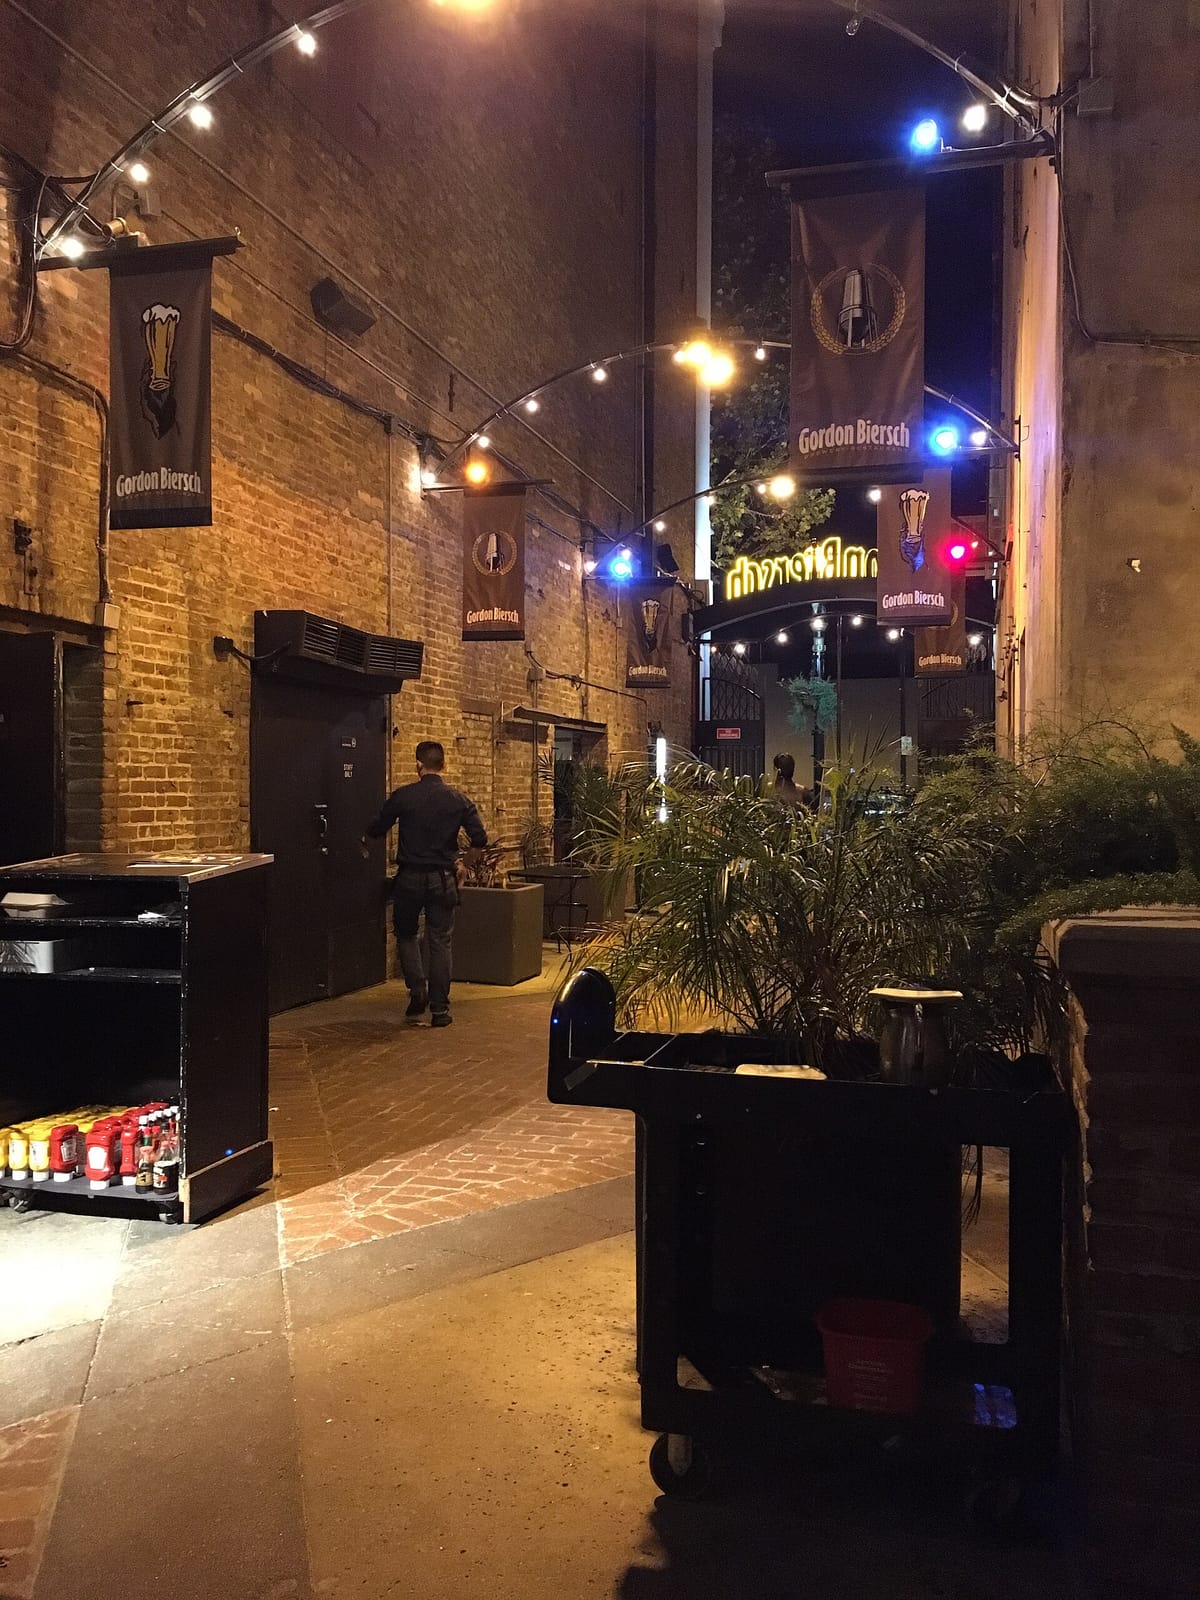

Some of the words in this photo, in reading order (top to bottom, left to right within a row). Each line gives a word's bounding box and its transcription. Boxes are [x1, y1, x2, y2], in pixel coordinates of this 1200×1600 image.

[798, 423, 854, 454] Gordon
[856, 419, 910, 448] Biersch
[116, 470, 159, 497] Gordon
[160, 467, 201, 493] Biersch
[882, 592, 913, 609] Gordon
[914, 590, 945, 607] Biersch
[466, 609, 493, 624] Gordon
[494, 607, 519, 623] Biersch
